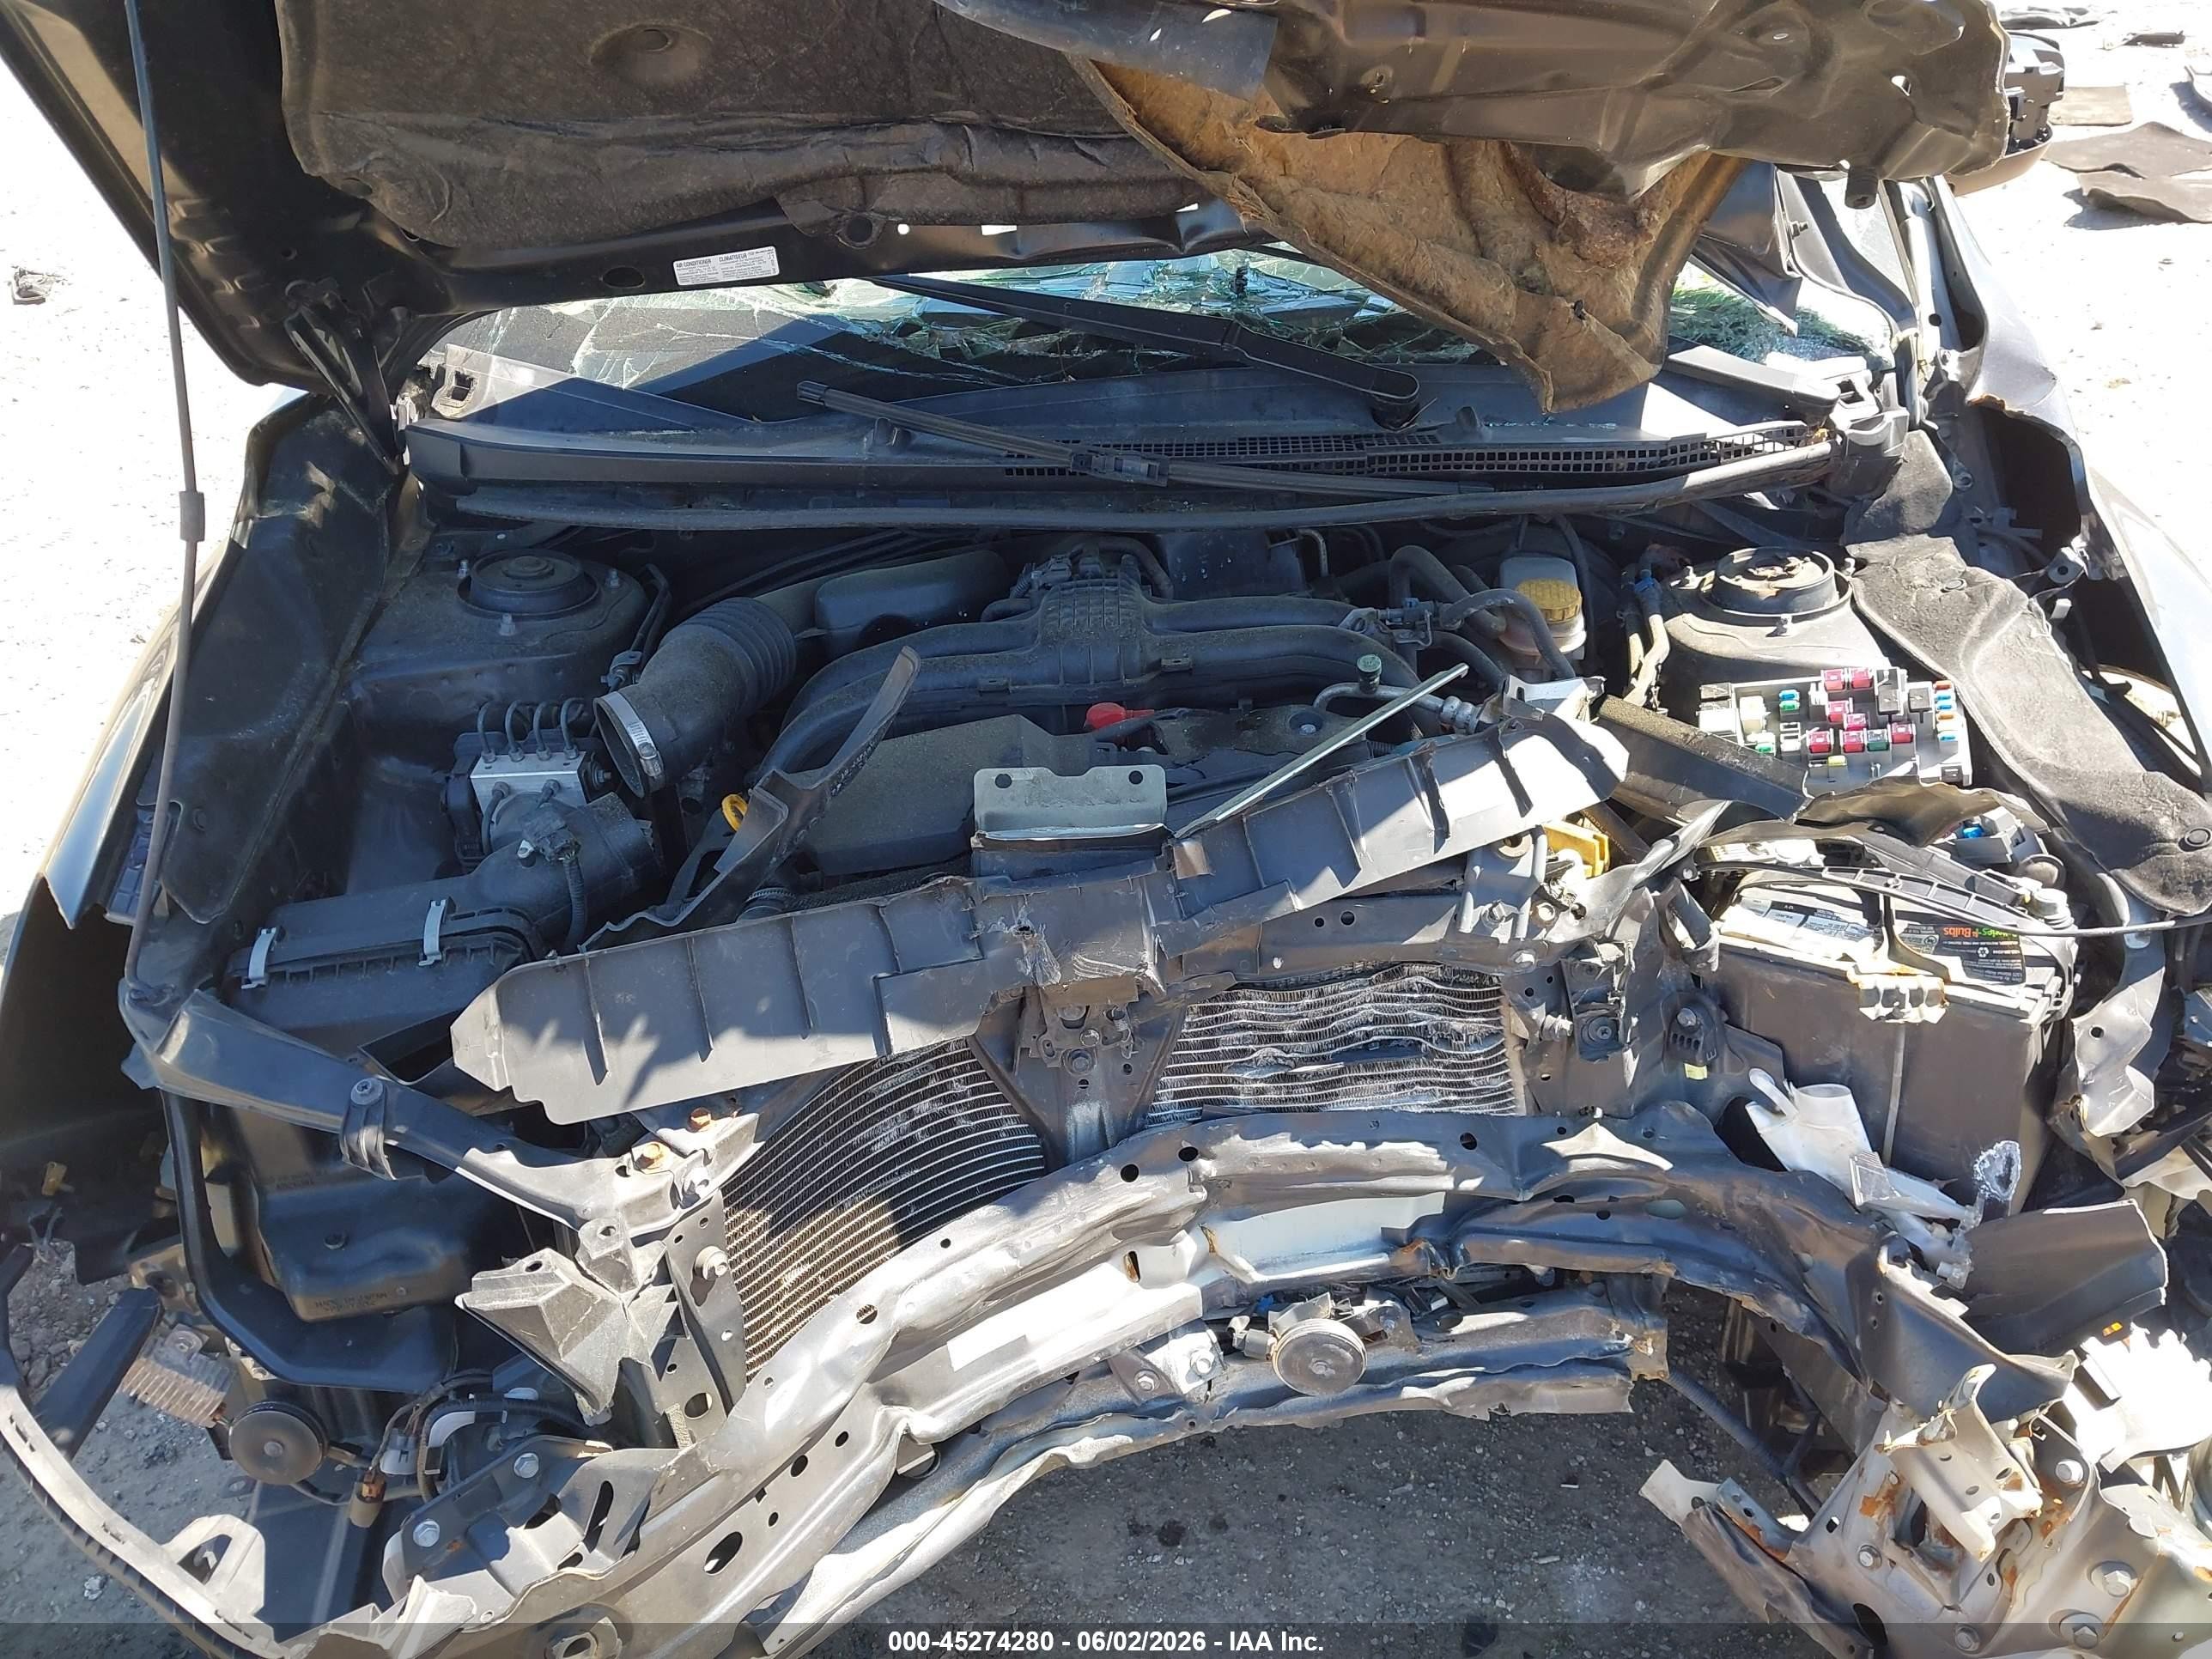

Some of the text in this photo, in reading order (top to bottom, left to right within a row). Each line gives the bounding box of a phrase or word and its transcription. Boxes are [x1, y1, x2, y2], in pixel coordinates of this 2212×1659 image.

[719, 252, 748, 262] CLIMATISEUR
[684, 258, 712, 267] CONDITIONER
[1943, 927, 1972, 938] Bulbs
